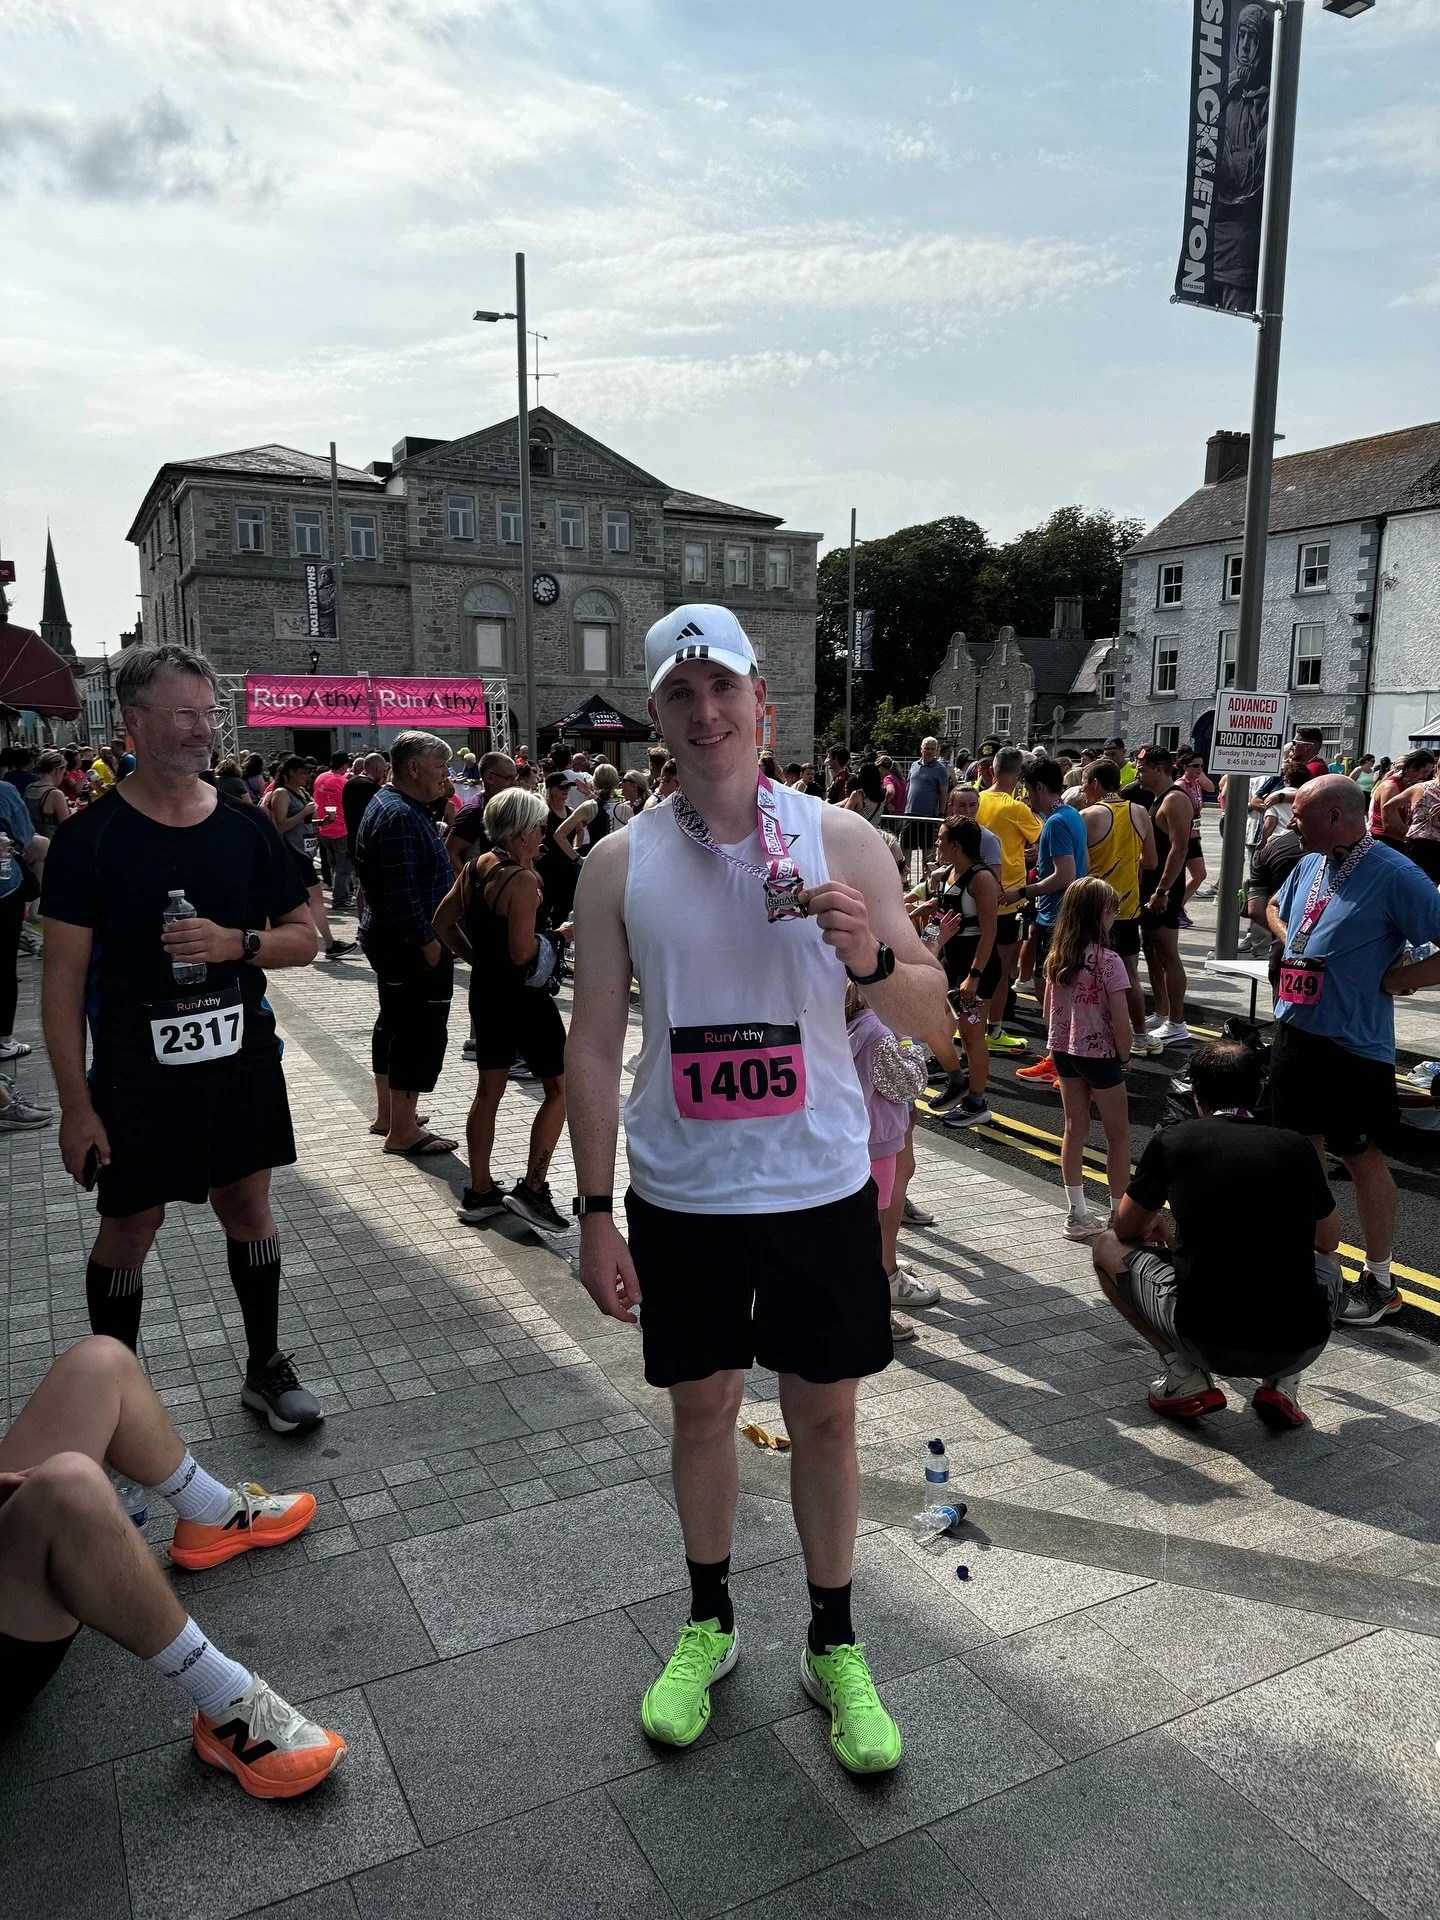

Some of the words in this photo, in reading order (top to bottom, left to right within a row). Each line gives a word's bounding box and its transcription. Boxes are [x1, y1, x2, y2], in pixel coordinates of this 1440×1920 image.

[1181, 0, 1225, 294] SHACKLETON
[306, 565, 320, 636] SHACKLETON
[854, 611, 863, 667] SHACKLETON
[1227, 697, 1278, 713] ADVANCED
[1229, 714, 1273, 730] WARNING
[1217, 749, 1240, 758] Sunday
[1255, 751, 1277, 759] August
[1219, 732, 1244, 746] ROAD
[1245, 734, 1278, 748] CLOSED
[159, 1012, 240, 1055] 2317
[682, 1055, 797, 1104] 1405
